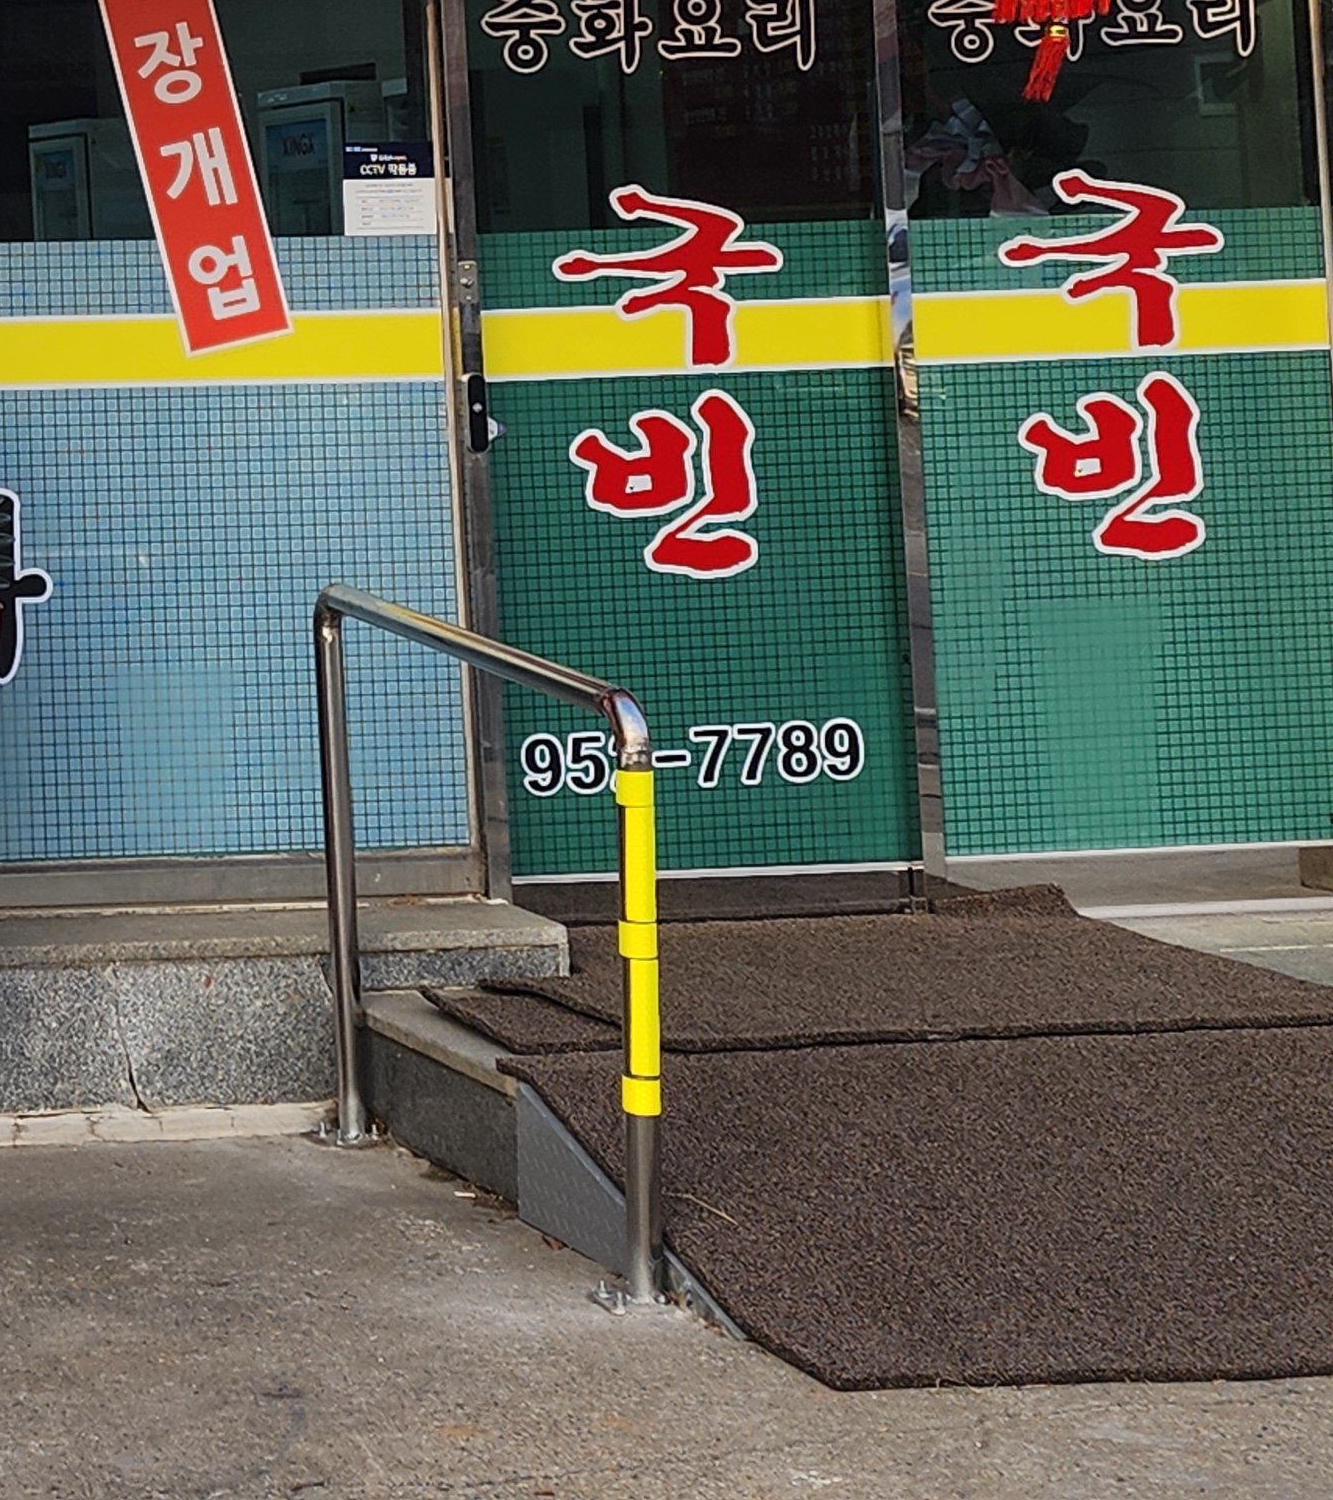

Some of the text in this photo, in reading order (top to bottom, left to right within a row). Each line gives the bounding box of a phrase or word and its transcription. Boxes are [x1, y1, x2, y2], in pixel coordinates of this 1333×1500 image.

[359, 164, 386, 176] CCTV
[552, 182, 785, 579] 국빈
[999, 167, 1226, 561] 국빈
[520, 717, 867, 797] 95-7789
